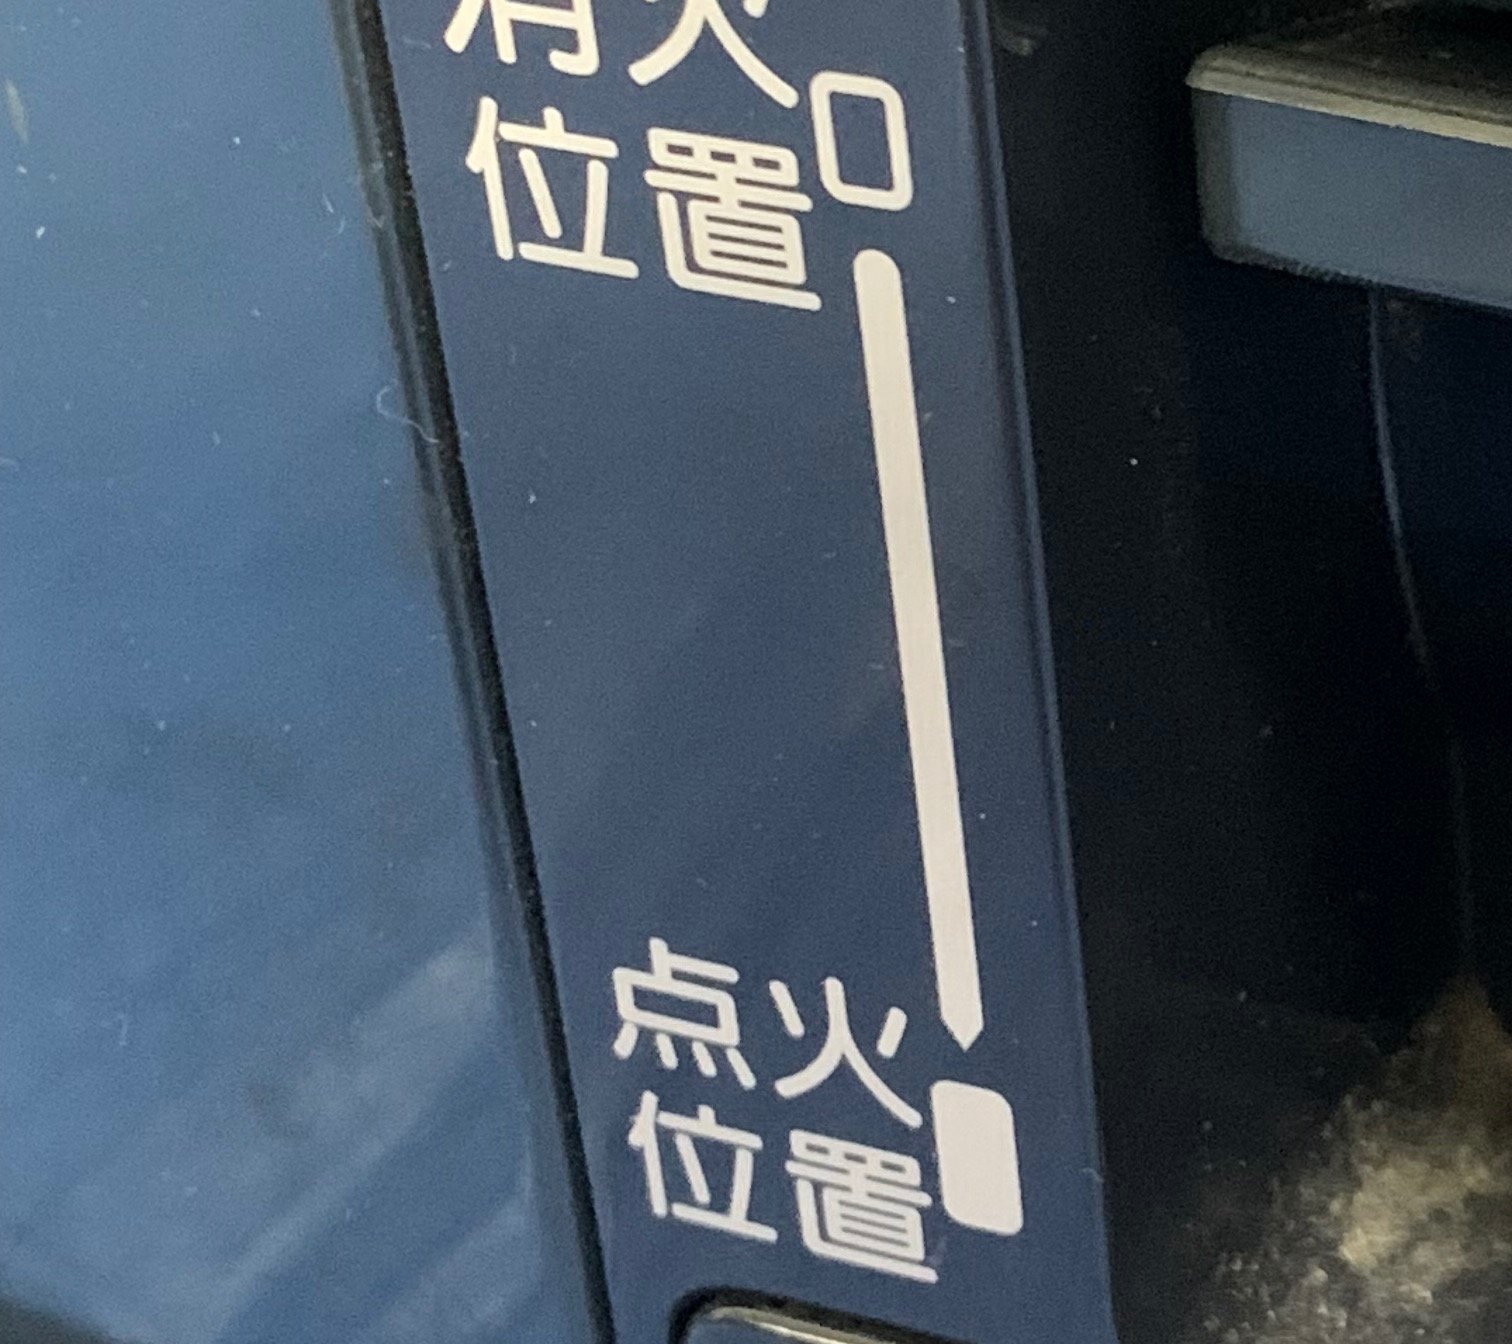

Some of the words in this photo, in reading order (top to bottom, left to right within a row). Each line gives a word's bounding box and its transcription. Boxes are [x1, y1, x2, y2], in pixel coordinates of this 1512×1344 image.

[464, 96, 823, 312] 位置
[611, 936, 924, 1129] 点火
[627, 1089, 939, 1284] 位置
